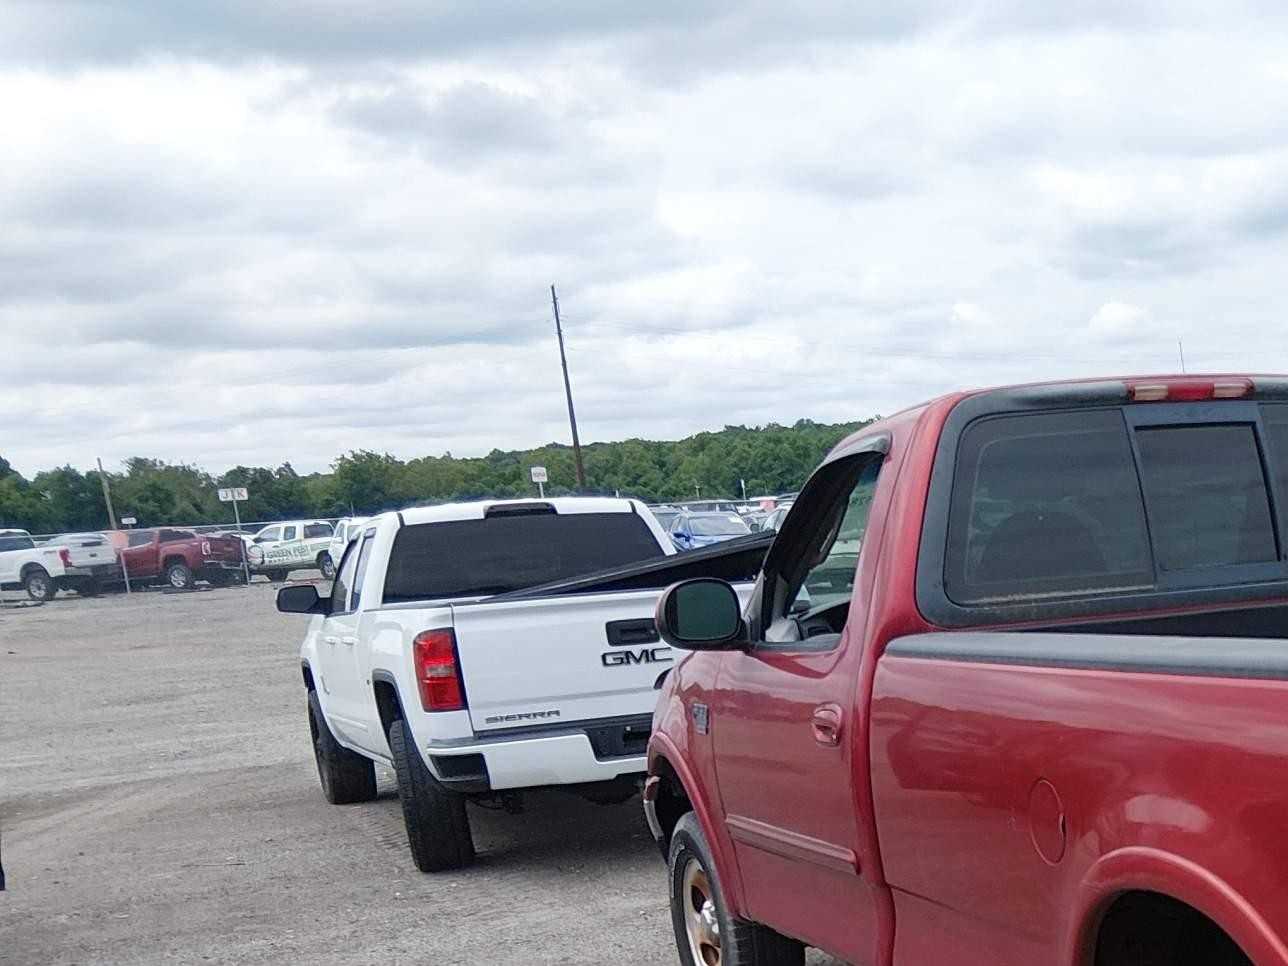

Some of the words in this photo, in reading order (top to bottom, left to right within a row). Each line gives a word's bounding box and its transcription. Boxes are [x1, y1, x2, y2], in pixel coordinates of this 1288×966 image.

[266, 548, 292, 559] GREEN
[601, 646, 674, 667] GMC
[485, 709, 561, 724] SIERRA
